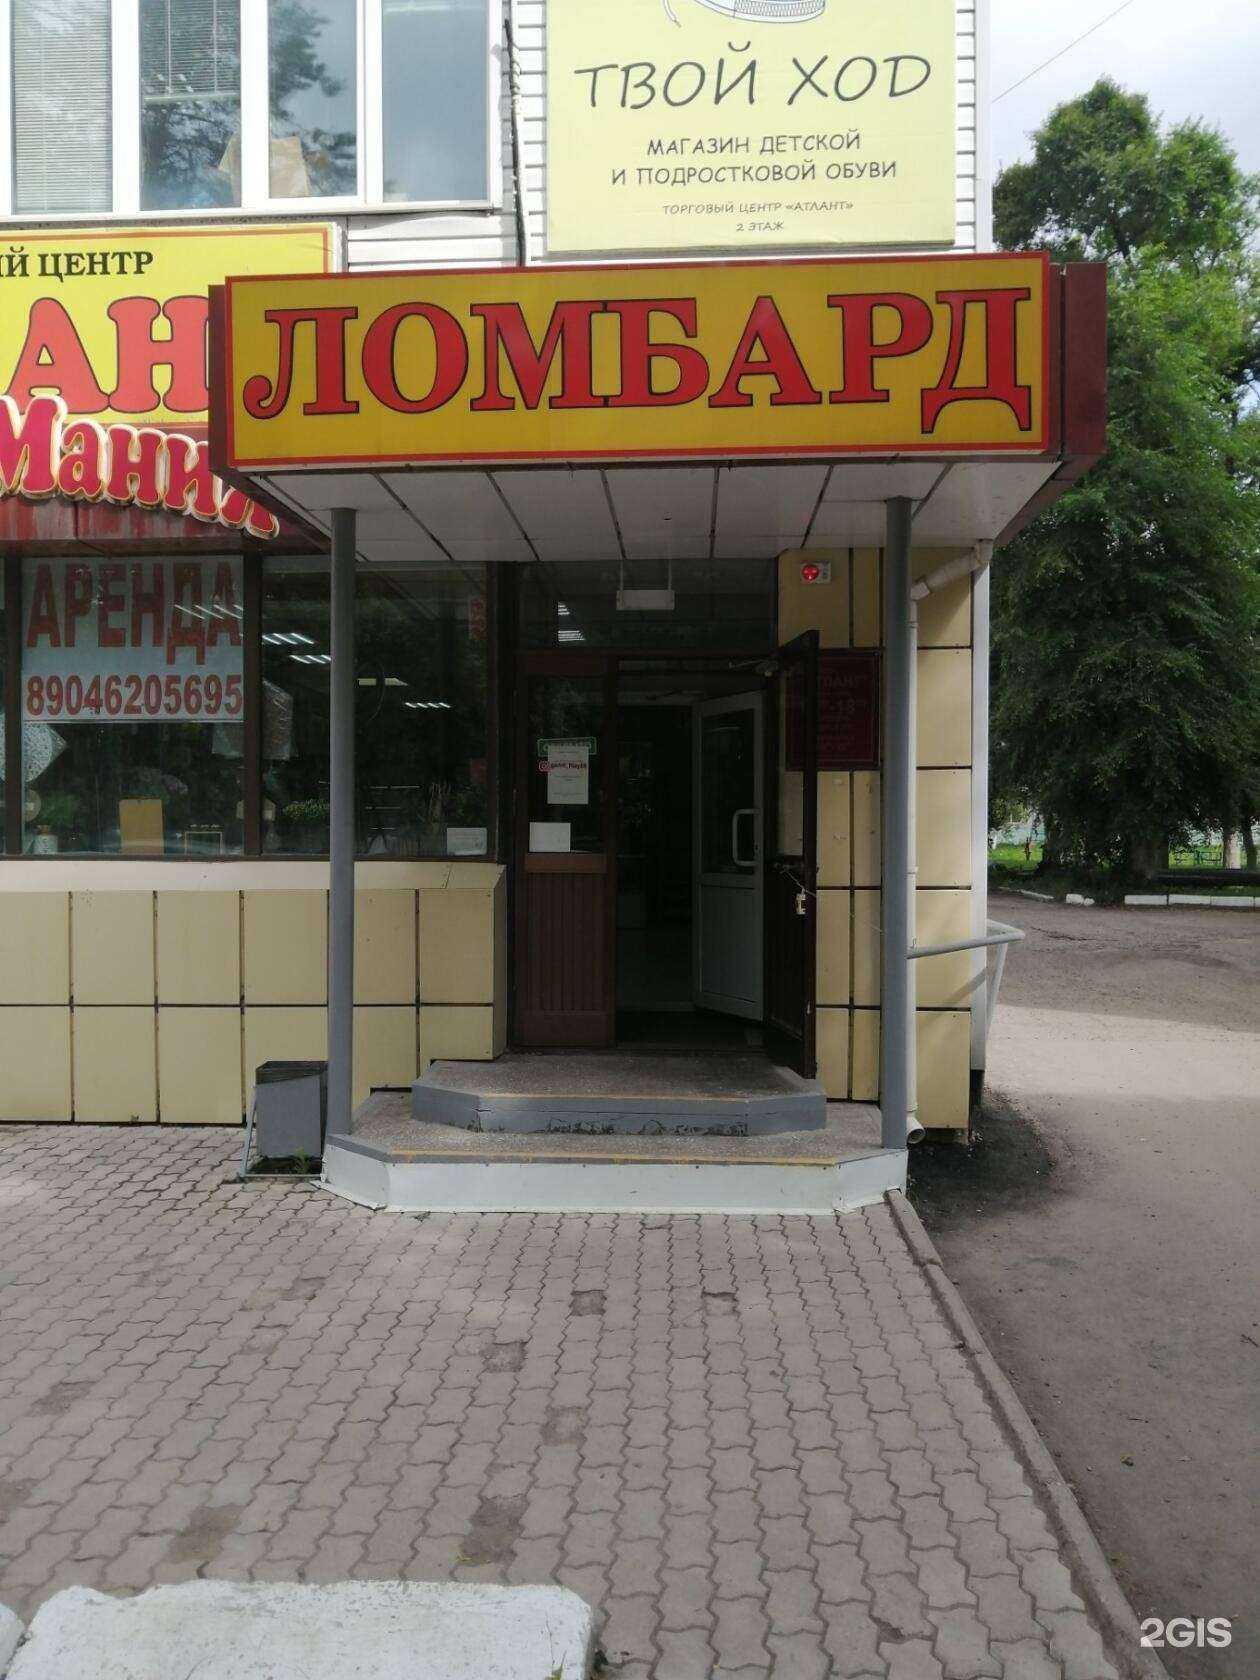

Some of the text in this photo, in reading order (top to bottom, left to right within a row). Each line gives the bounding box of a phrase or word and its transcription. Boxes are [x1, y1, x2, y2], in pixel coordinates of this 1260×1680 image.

[574, 41, 931, 109] ТВОЙ ХОД
[647, 129, 861, 156] МАГАЗИН ДЕТСКОЙ
[611, 160, 897, 186] И ПОДРОСТКОВОЙ ОБУВИ
[662, 201, 735, 216] ТОРГОВЫЙ
[738, 202, 782, 214] ЦЕНТР
[736, 221, 784, 232] 2 ЭТАЖ
[38, 251, 154, 282] ЦЕНТР
[243, 287, 1033, 435] ЛОМБАРД
[26, 561, 243, 666] АРЕНДА
[26, 674, 243, 716] 89046205695
